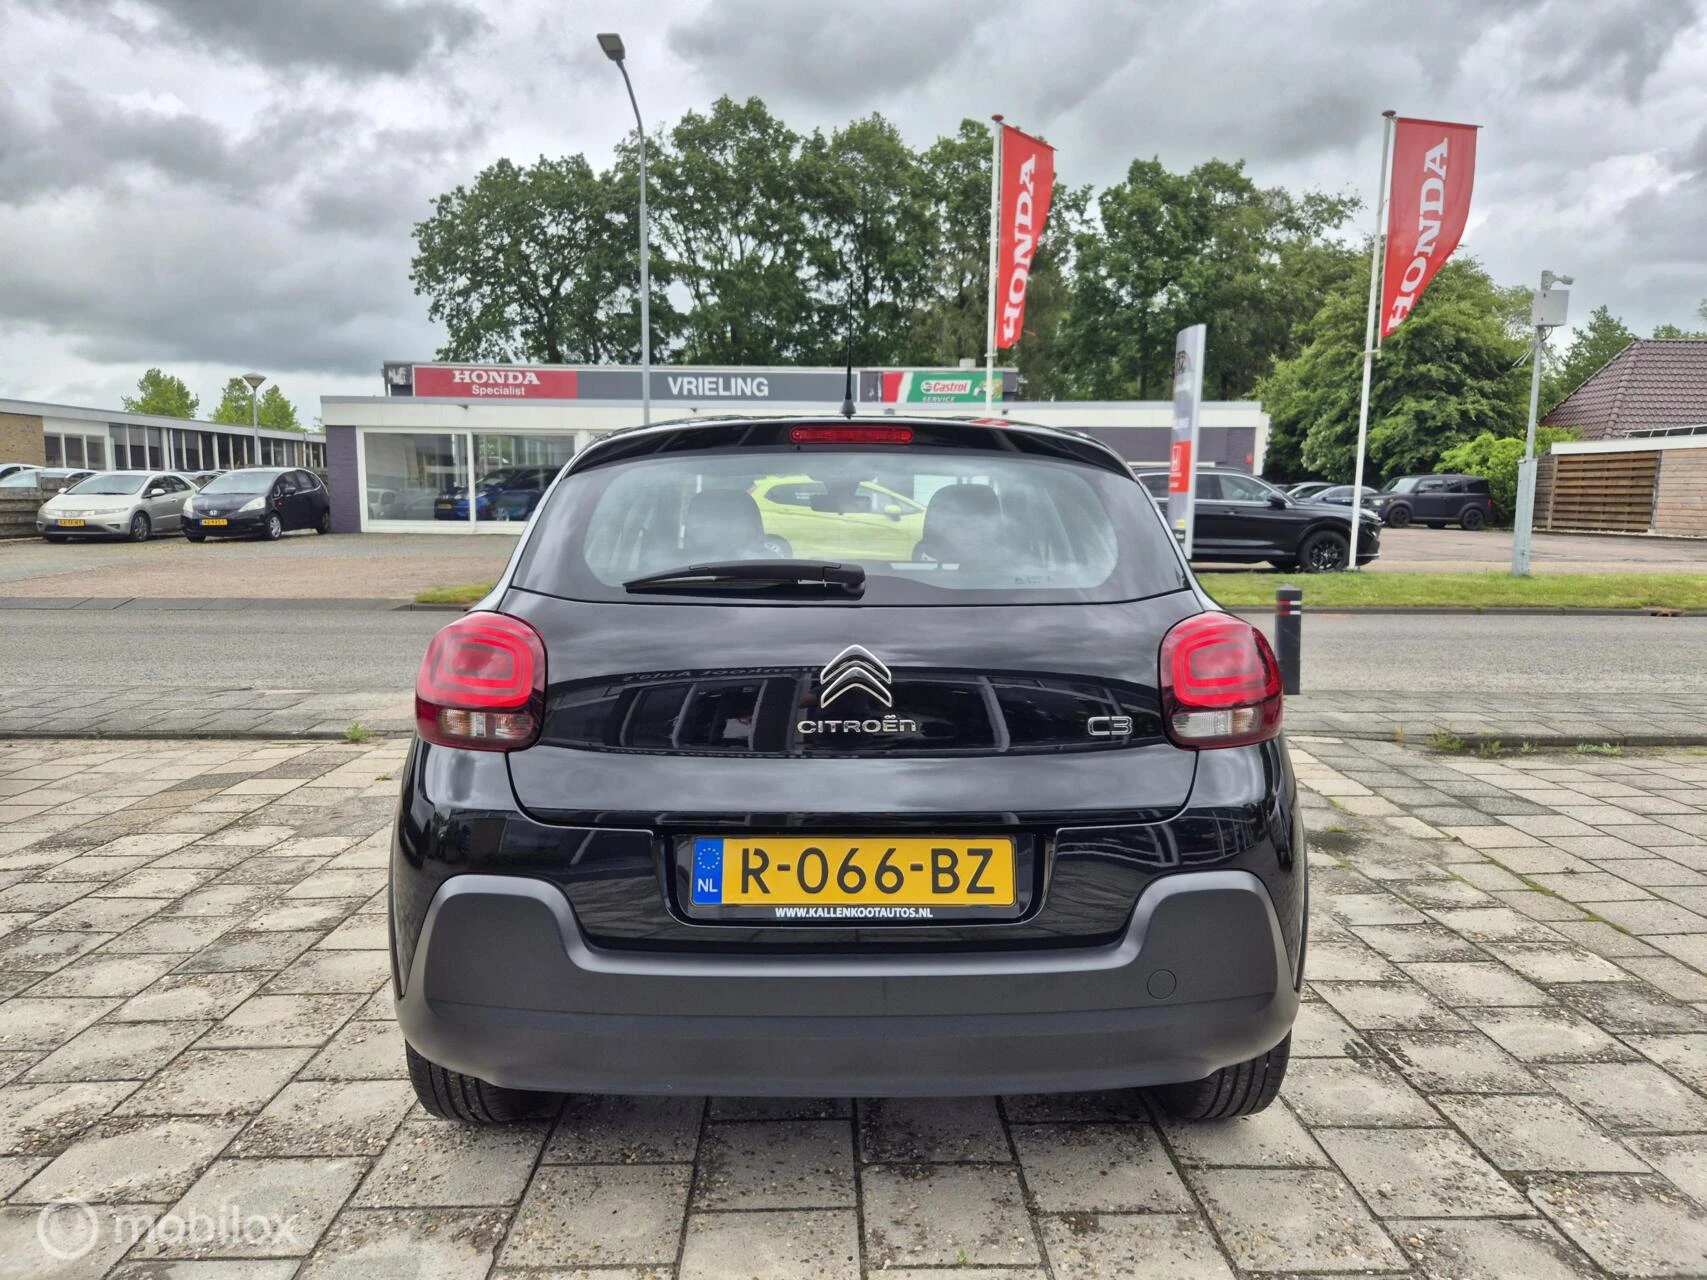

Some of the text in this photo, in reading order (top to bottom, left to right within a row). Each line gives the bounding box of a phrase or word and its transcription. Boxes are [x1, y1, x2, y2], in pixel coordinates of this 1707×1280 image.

[1386, 137, 1448, 332] HONDA
[1002, 153, 1036, 341] HONDA
[452, 369, 541, 385] HONDA
[667, 376, 769, 396] VRIELING
[471, 384, 526, 396] Specialist
[932, 382, 967, 393] Castrol
[1088, 716, 1133, 736] C3
[740, 847, 995, 895] R-066-BZ
[697, 878, 719, 893] NL
[775, 907, 934, 919] WWW.KALLENKOOTAUTOS.NL
